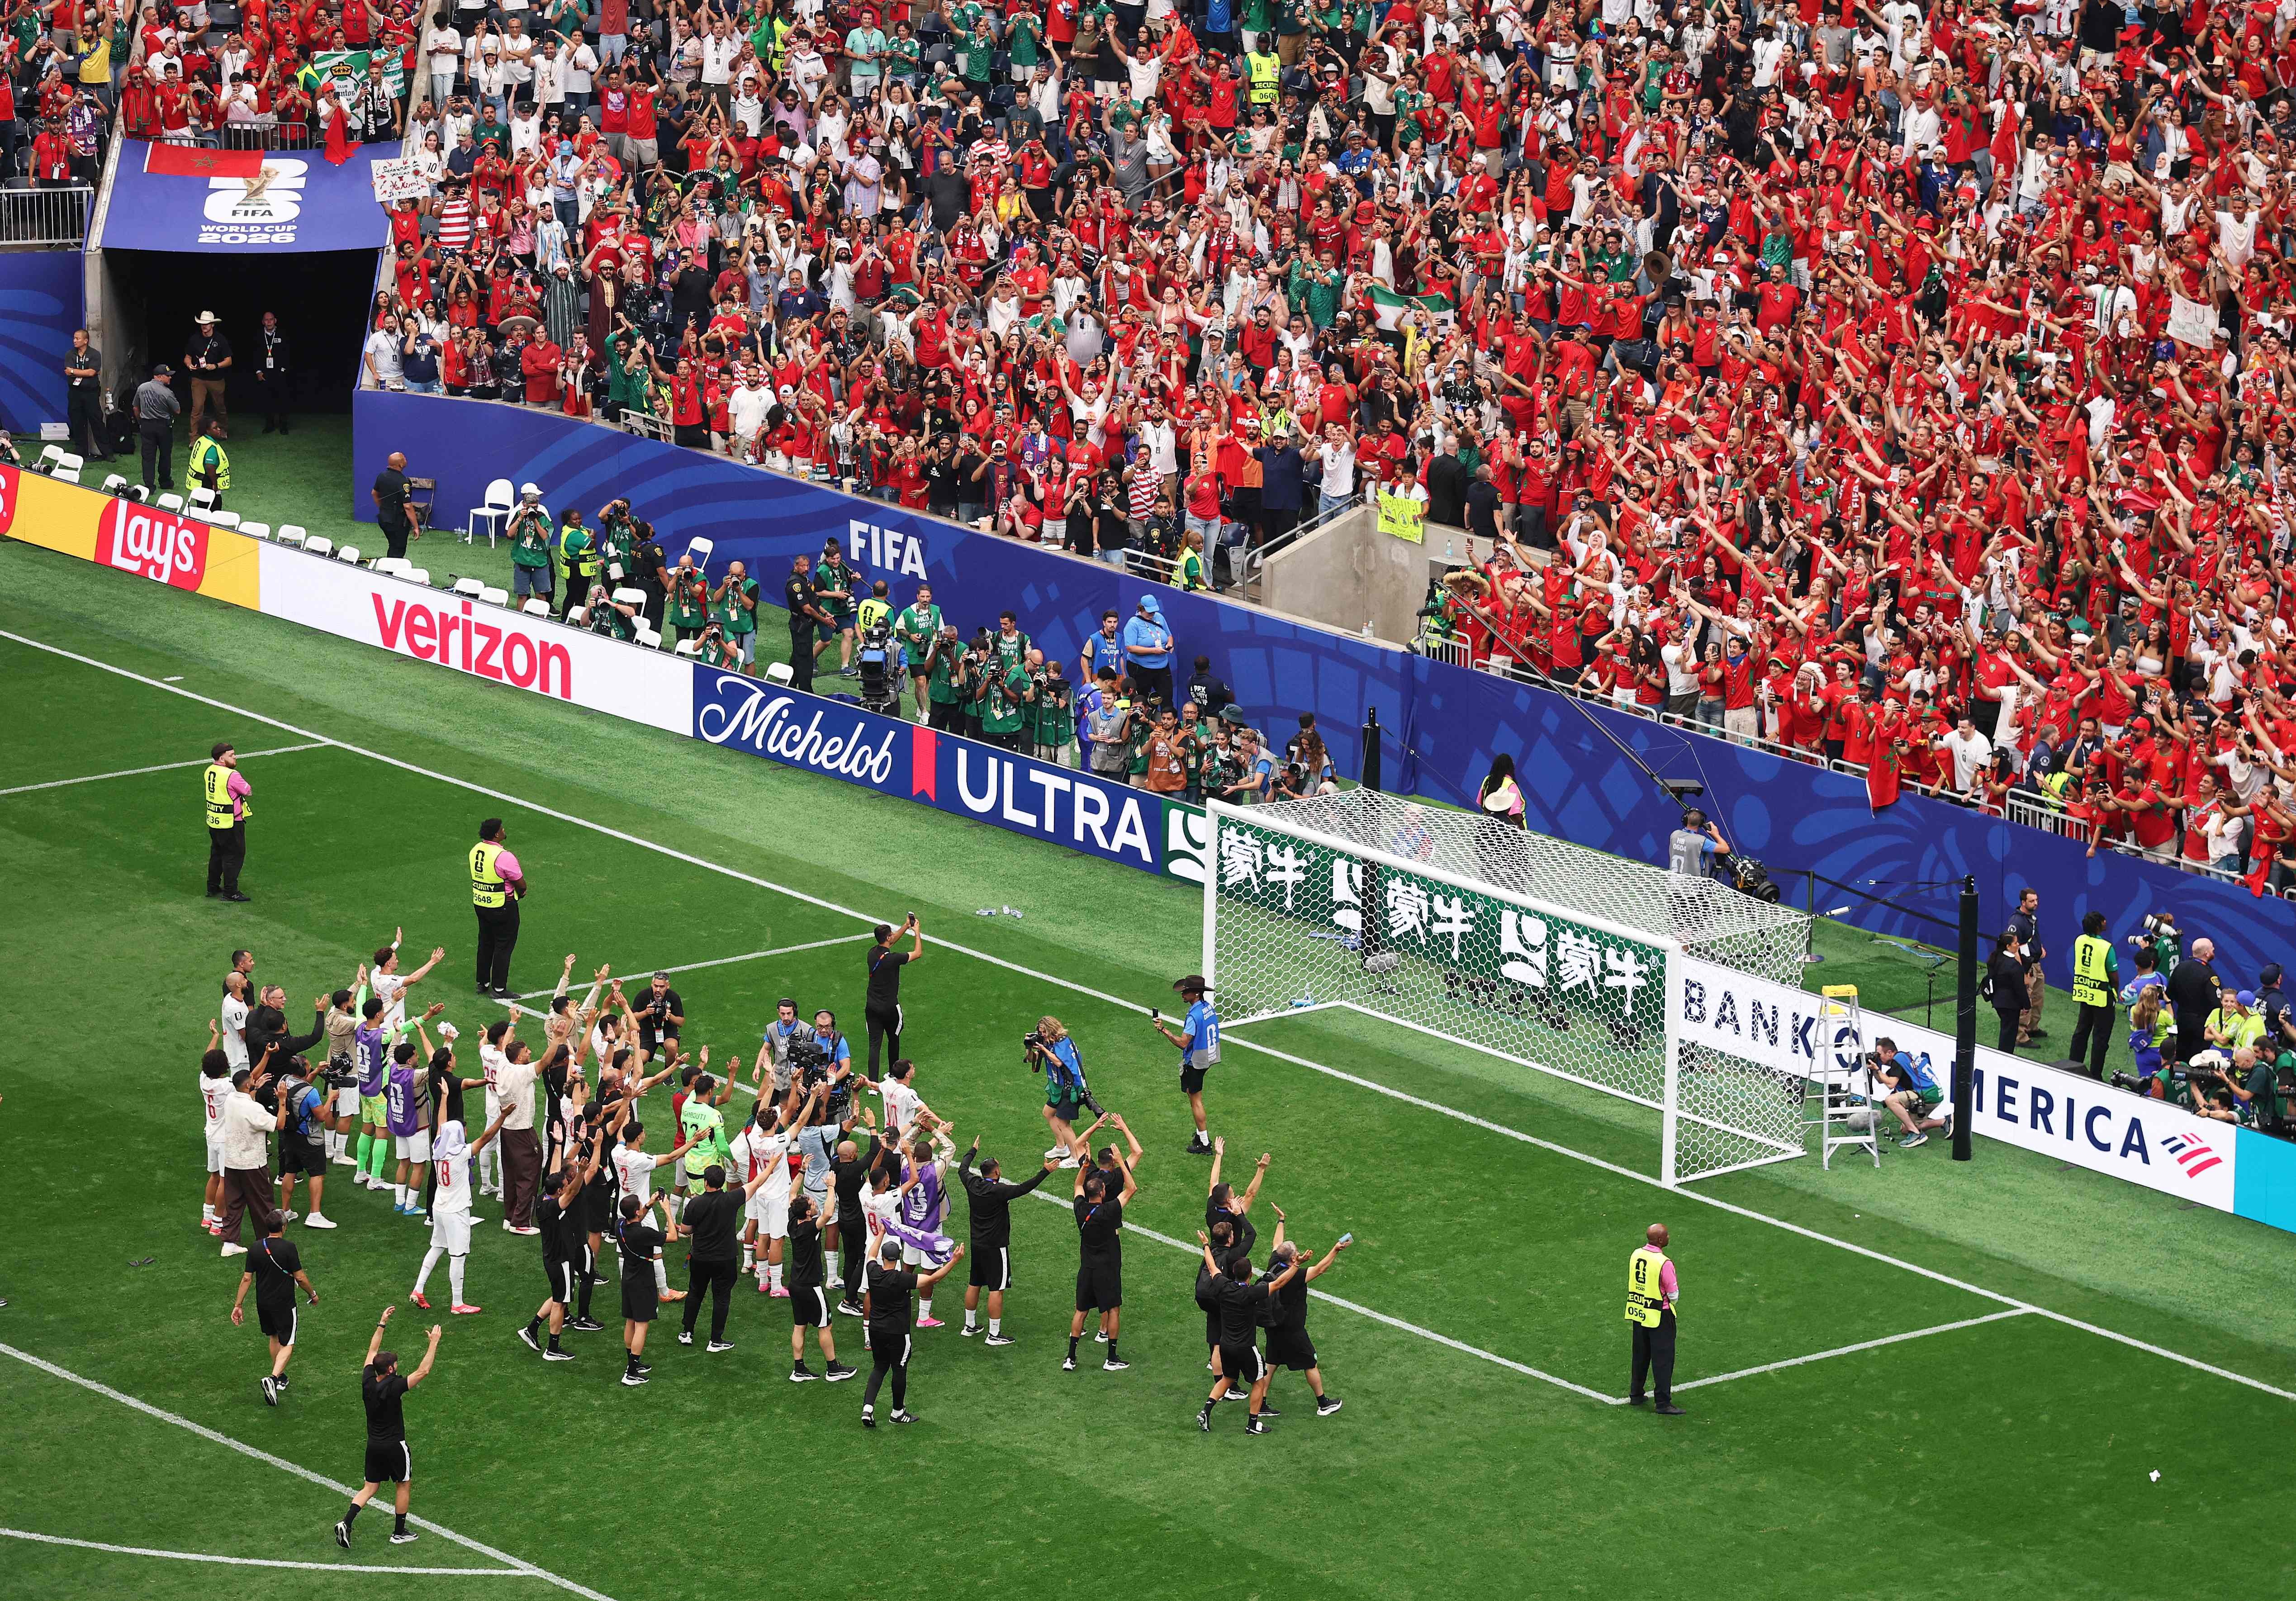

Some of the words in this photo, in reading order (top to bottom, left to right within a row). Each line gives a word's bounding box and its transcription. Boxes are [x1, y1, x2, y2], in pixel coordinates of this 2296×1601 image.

[427, 162, 437, 173] 10
[198, 233, 295, 243] 2026
[2083, 301, 2094, 312] 20
[2195, 306, 2206, 324] U
[1851, 485, 1860, 509] FIFA
[111, 499, 195, 584] Lay's
[849, 519, 927, 580] FIFA
[1467, 615, 1472, 624] 2
[372, 593, 571, 699] verizon
[699, 676, 896, 784] Michelob
[957, 747, 1153, 863] ULTRA
[1673, 843, 1687, 852] 0604
[1222, 825, 1308, 909] 蒙牛
[1387, 876, 1476, 960] 蒙牛
[1557, 929, 1649, 1016] 蒙牛
[1684, 978, 1816, 1060] BANK
[208, 1095, 217, 1119] 6
[886, 1102, 898, 1126] 10
[436, 1159, 451, 1187] 18
[620, 1166, 630, 1193] 2
[868, 1211, 879, 1236] 8
